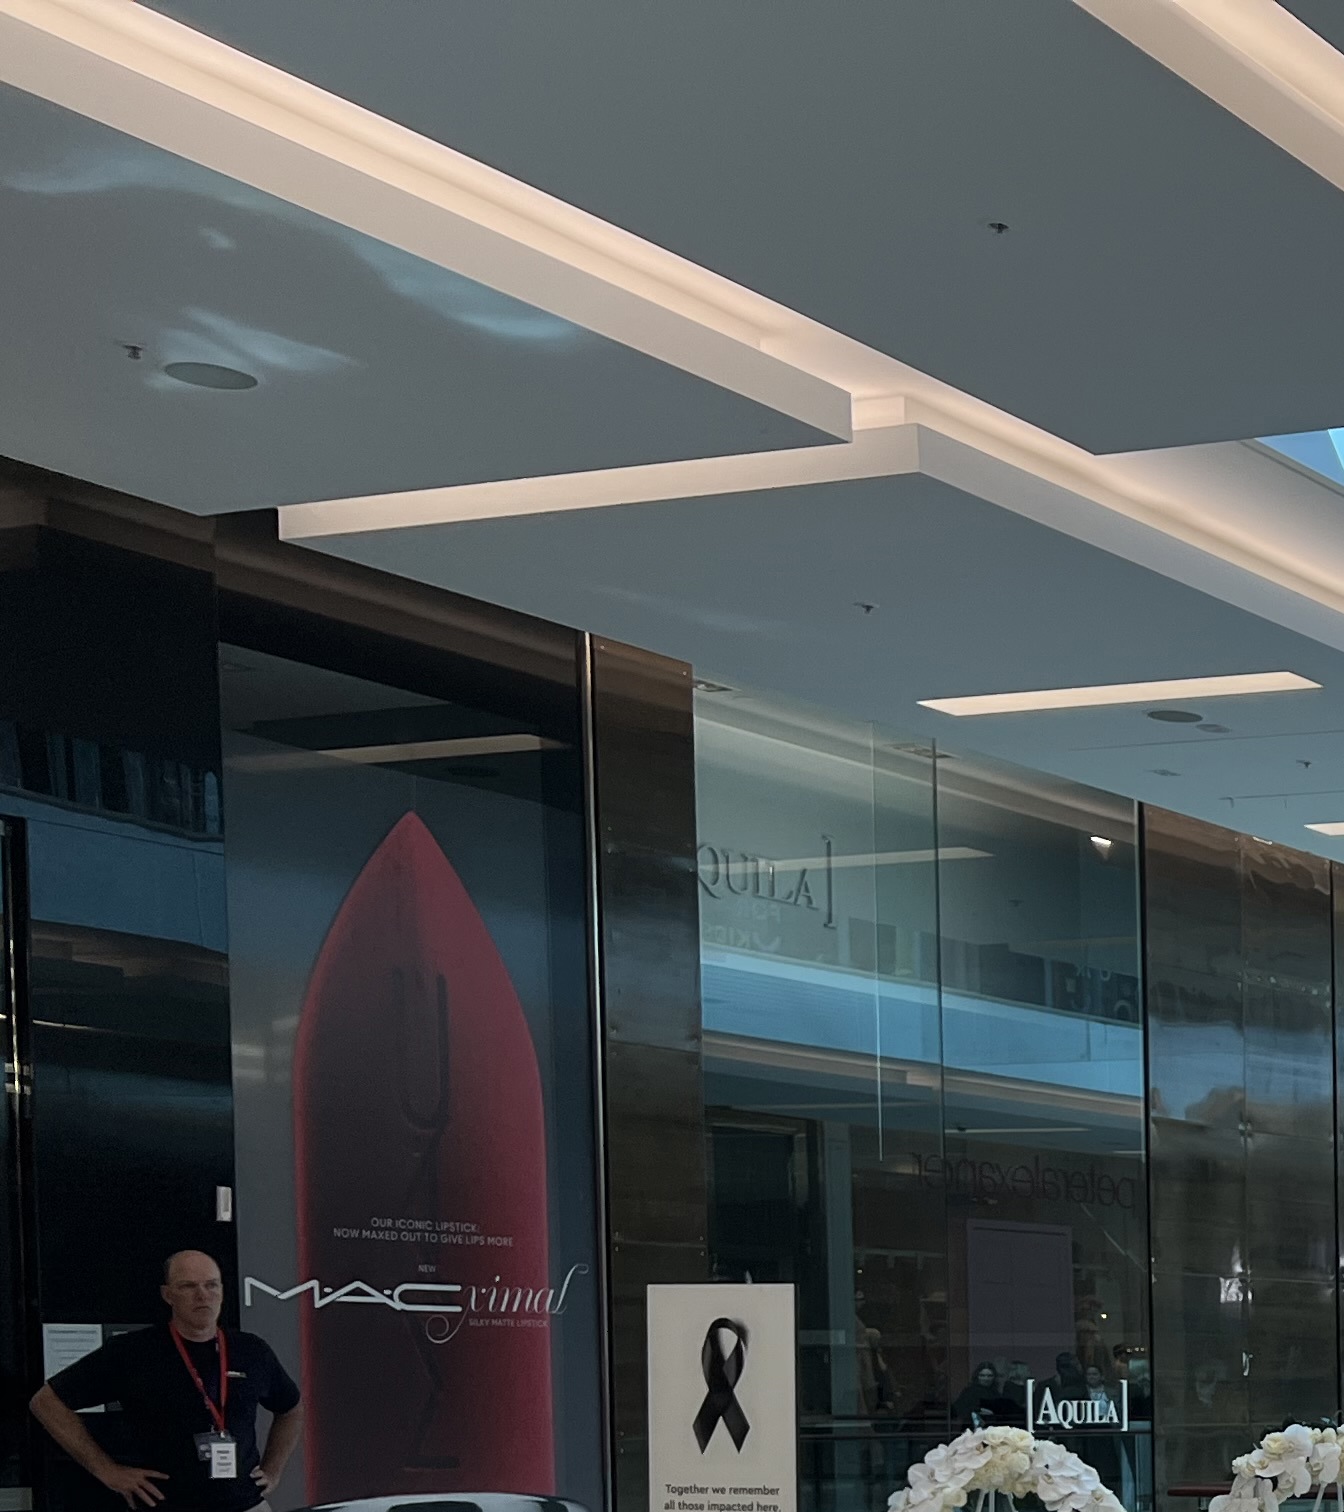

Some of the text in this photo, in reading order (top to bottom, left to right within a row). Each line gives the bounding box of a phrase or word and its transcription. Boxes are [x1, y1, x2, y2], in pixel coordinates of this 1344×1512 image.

[371, 1217, 392, 1228] OUR
[395, 1218, 433, 1230] ICONIC
[333, 1228, 513, 1247] NOW MAXED OUT TO GIVE LIPS MORE
[418, 1264, 437, 1273] NEW
[665, 1484, 780, 1496] Together we remember
[664, 1500, 675, 1511] all
[678, 1502, 705, 1511] those
[708, 1502, 753, 1512] impacted
